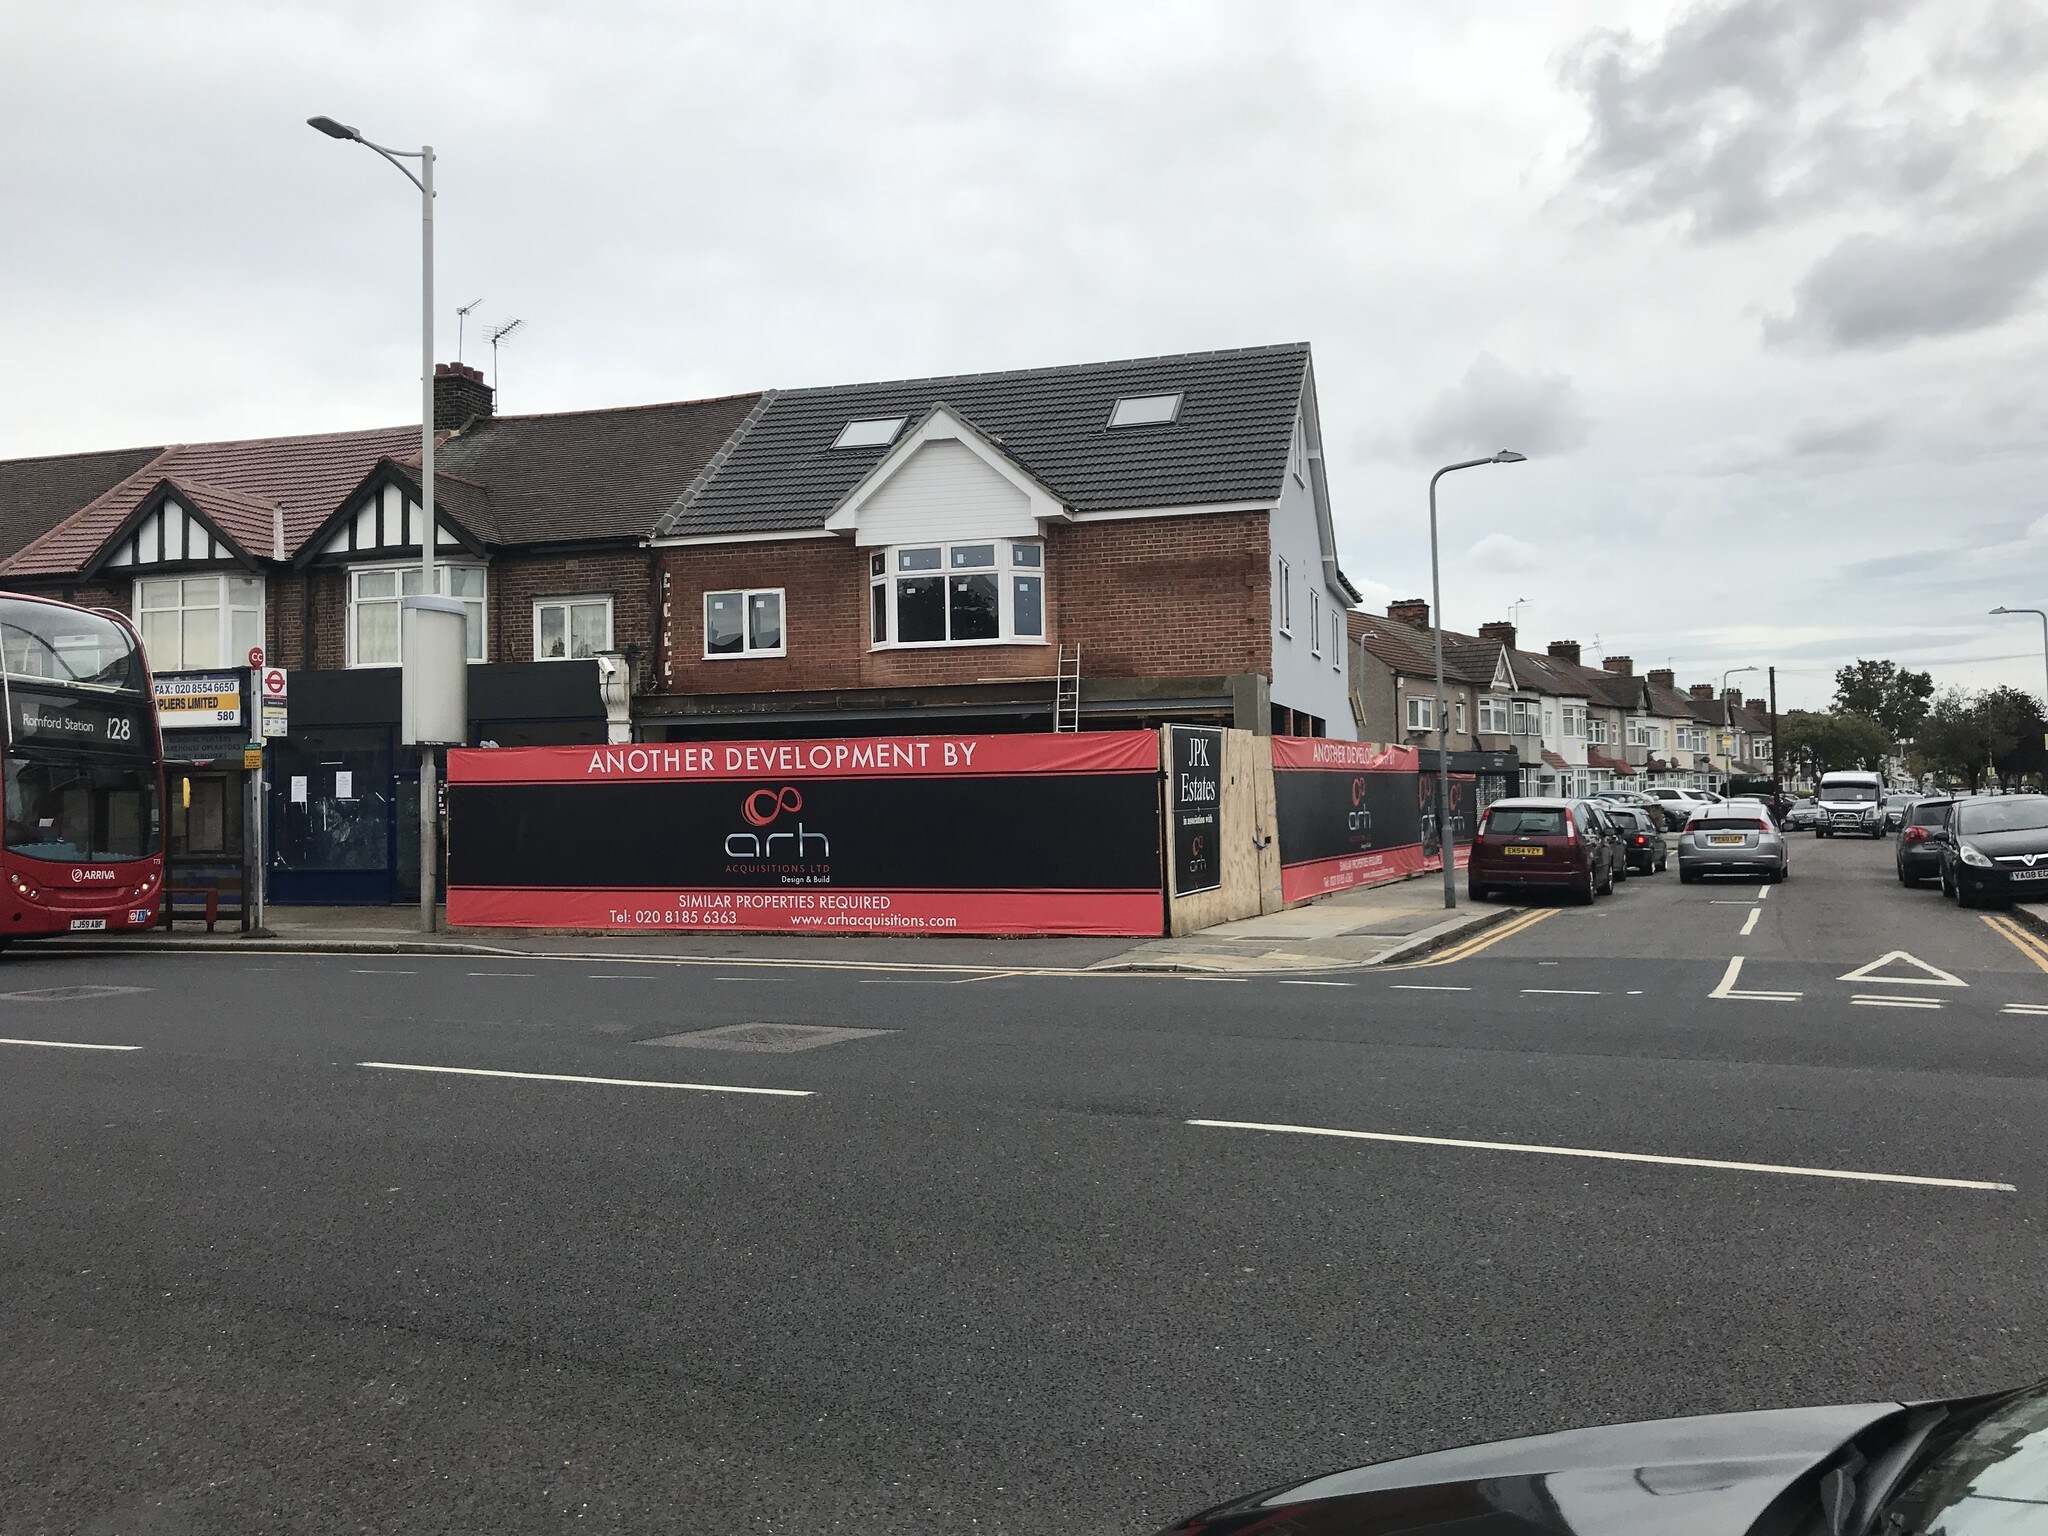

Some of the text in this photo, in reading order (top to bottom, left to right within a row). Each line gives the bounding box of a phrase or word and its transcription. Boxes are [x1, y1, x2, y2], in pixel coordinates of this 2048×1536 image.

[251, 652, 263, 661] CC
[155, 682, 234, 694] FAX: 020 8554 6650
[188, 697, 218, 709] LIMITED
[23, 713, 94, 732] Romford Station
[217, 711, 234, 721] 580
[107, 717, 131, 740] 128
[588, 742, 977, 773] ANOTHER DEVELOPMENT BY
[1188, 738, 1210, 767] JPK
[1313, 744, 1346, 764] ANOTHER
[1180, 773, 1216, 803] Estates
[1188, 814, 1205, 825] association
[1349, 803, 1372, 830] arh
[725, 822, 830, 857] arh
[83, 870, 115, 880] ARRIVA
[725, 865, 830, 875] ACQUISITIONS LTD
[2014, 871, 2036, 879] YA08
[781, 876, 804, 885] Design
[679, 894, 891, 909] SIMILAR PROPERTIES REQUIRED
[610, 909, 737, 924] Tel: 020 8185 6363
[791, 911, 957, 929] www.arhacquisitions.com
